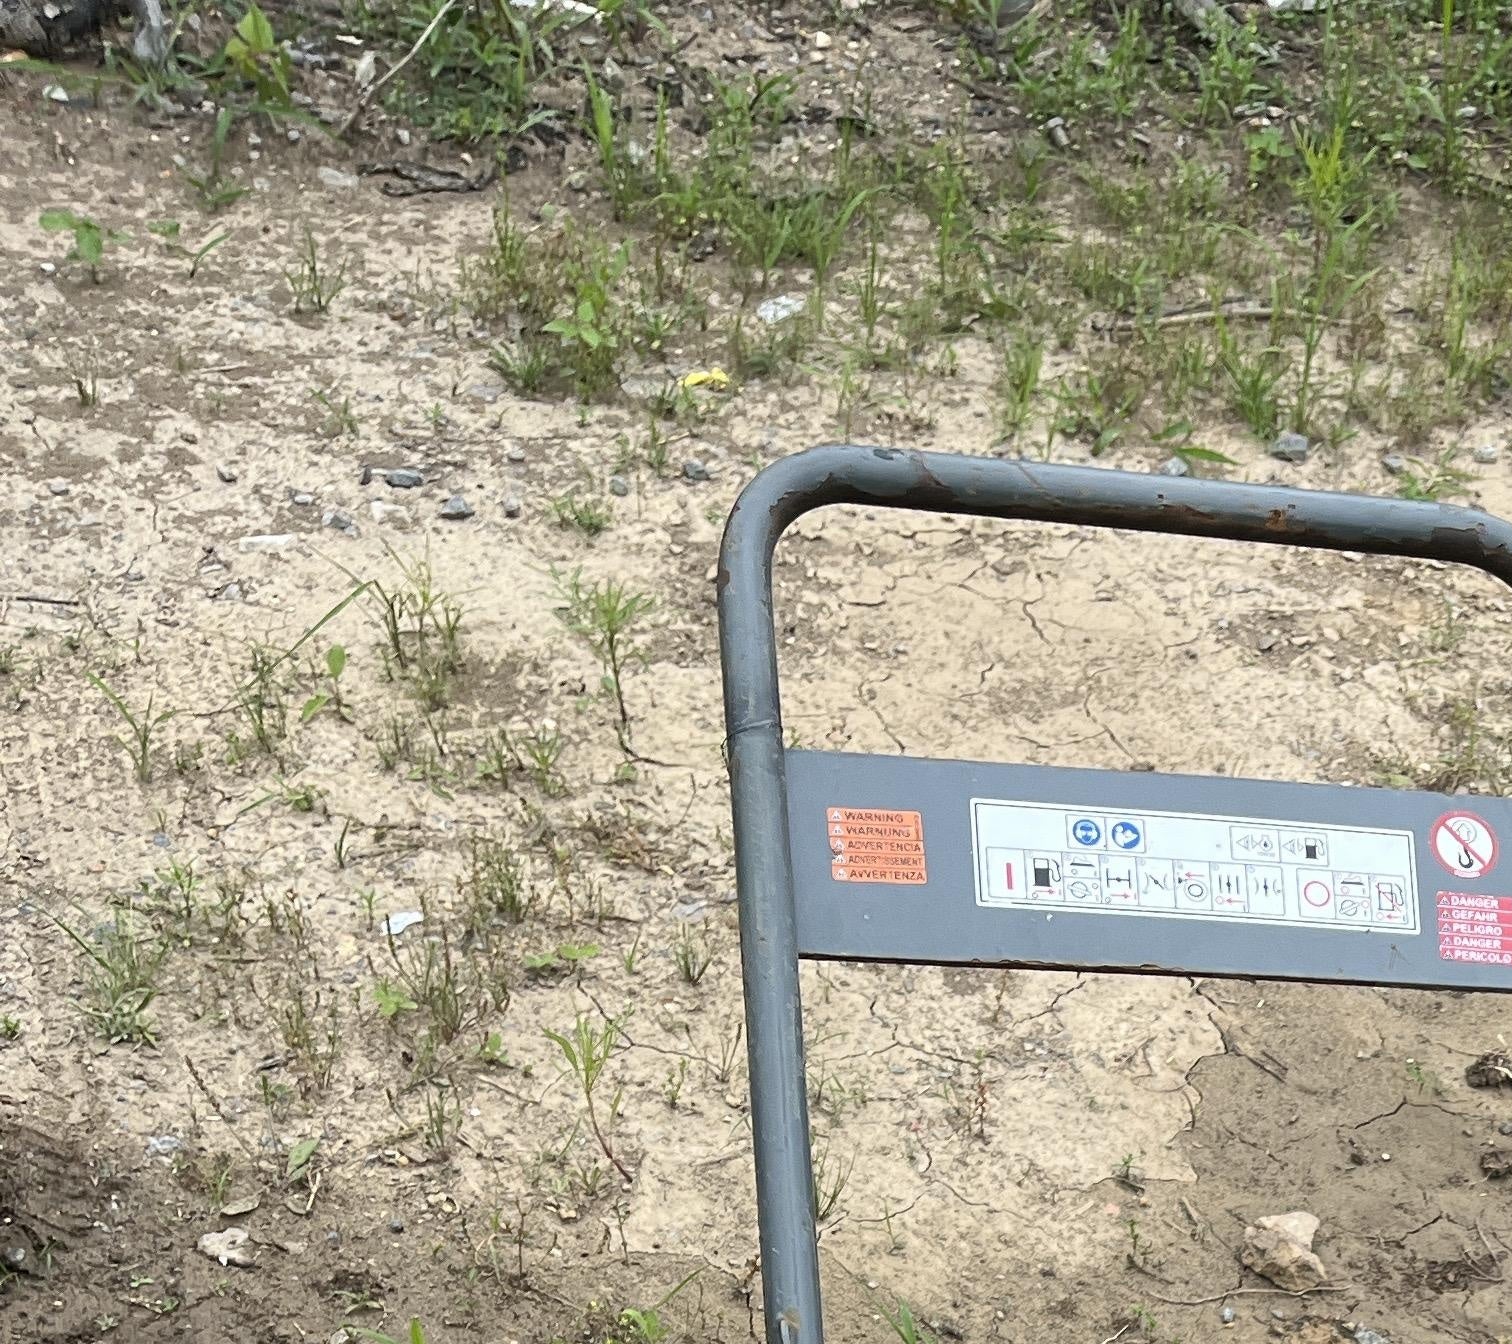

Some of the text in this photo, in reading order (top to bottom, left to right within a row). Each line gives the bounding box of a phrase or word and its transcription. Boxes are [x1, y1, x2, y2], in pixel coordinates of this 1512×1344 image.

[844, 811, 904, 823] WARNING
[846, 826, 911, 838] WARNUNG
[848, 840, 921, 852] ADVERTENCIA
[849, 869, 925, 881] AVVERTENZA
[1450, 895, 1499, 909] DANGER
[1452, 909, 1498, 922] GEFAHR
[1453, 923, 1503, 936] PELIGRO
[1453, 936, 1502, 949] DANGER
[1454, 949, 1512, 964] PERICOLO
